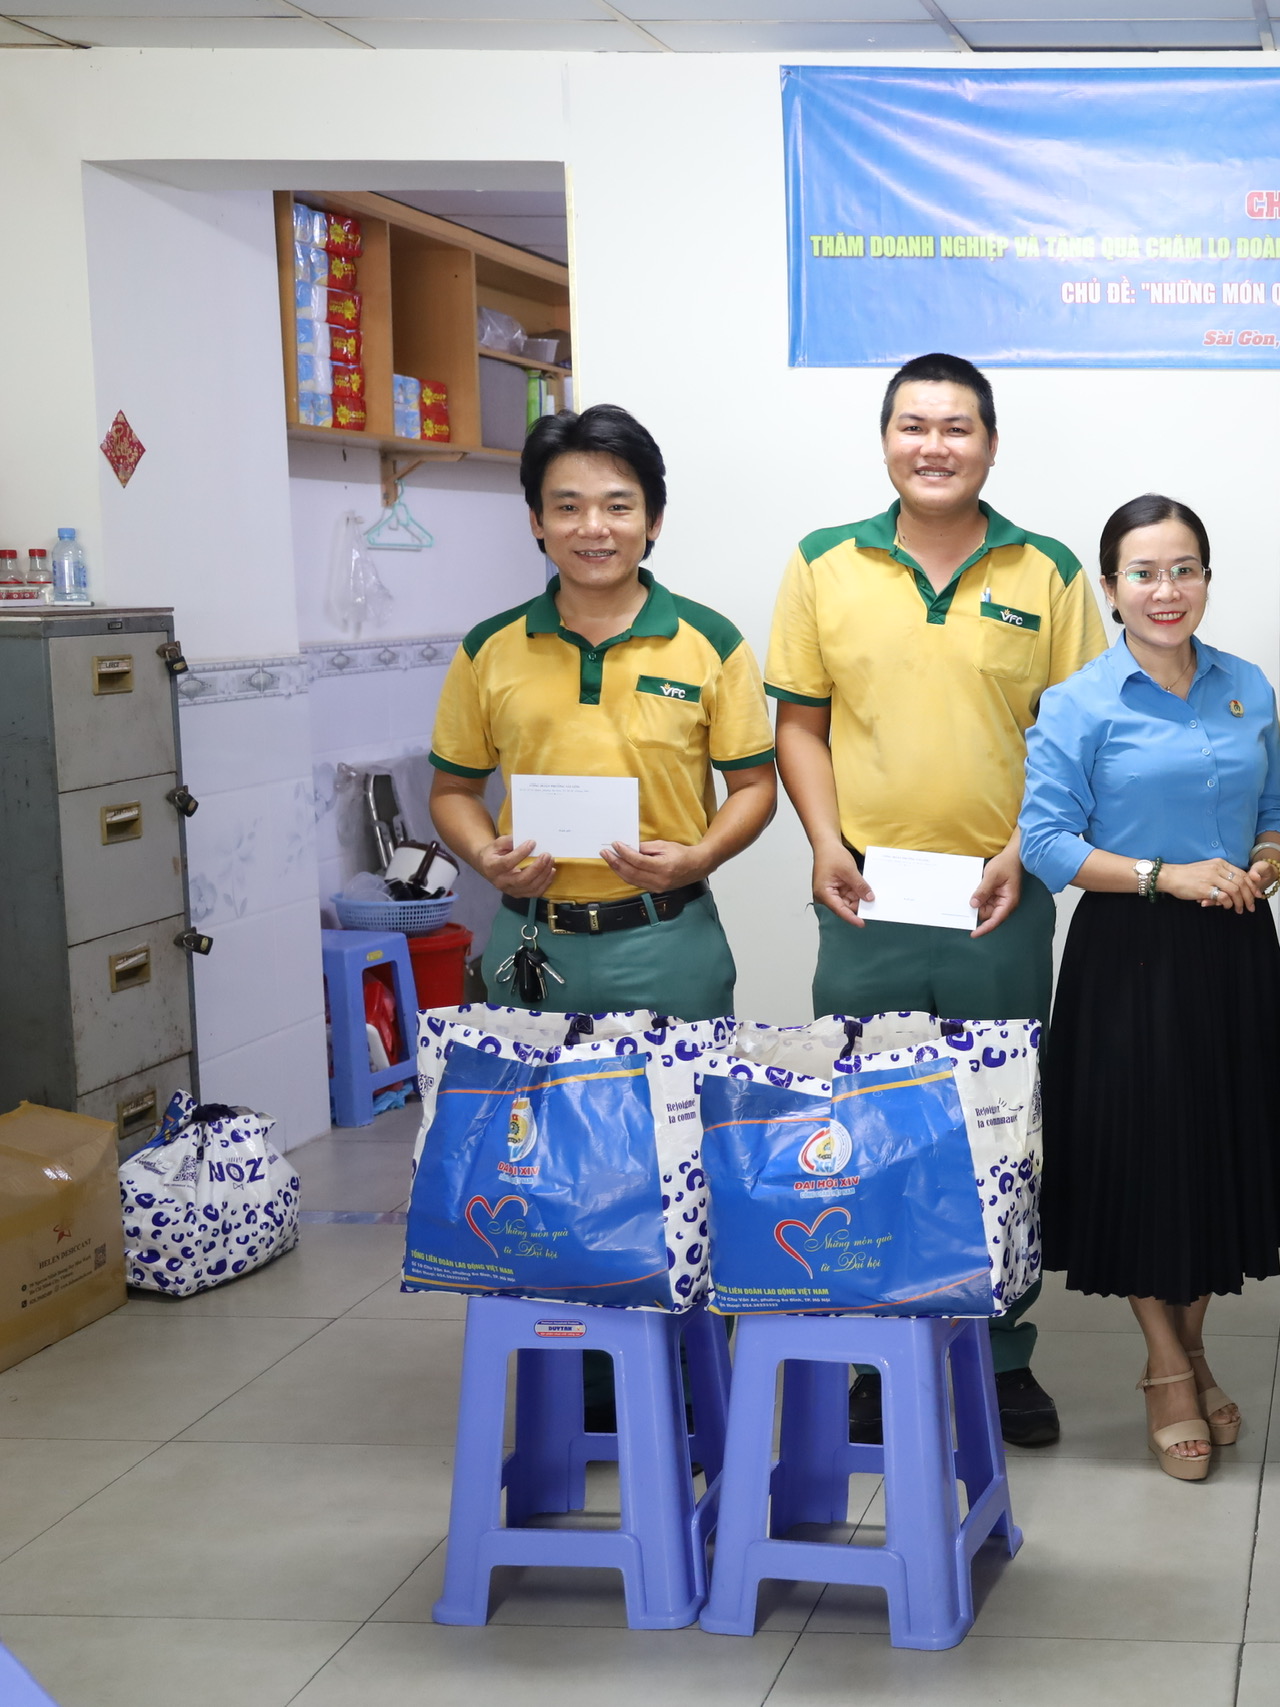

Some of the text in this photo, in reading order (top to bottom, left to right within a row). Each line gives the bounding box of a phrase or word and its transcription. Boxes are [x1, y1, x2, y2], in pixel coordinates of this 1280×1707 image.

[810, 232, 864, 257] THĂM
[870, 236, 935, 258] DOANH
[940, 233, 1009, 261] NGHIỆP
[1014, 234, 1040, 257] VÀ
[1044, 233, 1096, 261] TẶNG
[1101, 234, 1139, 261] QUÀ
[1146, 234, 1201, 258] CHĂM
[1208, 237, 1230, 258] LO
[1061, 278, 1100, 304] CHỦ
[1106, 277, 1136, 304] ĐỀ:
[1141, 280, 1216, 304] "NHỮNG
[1222, 280, 1266, 304] MÓN
[1203, 330, 1233, 347] Sài
[1237, 330, 1280, 349] Gòn,
[1000, 611, 1023, 625] VFC
[660, 685, 685, 698] VFC
[207, 1157, 265, 1183] NOZ
[840, 1176, 860, 1186] XIV
